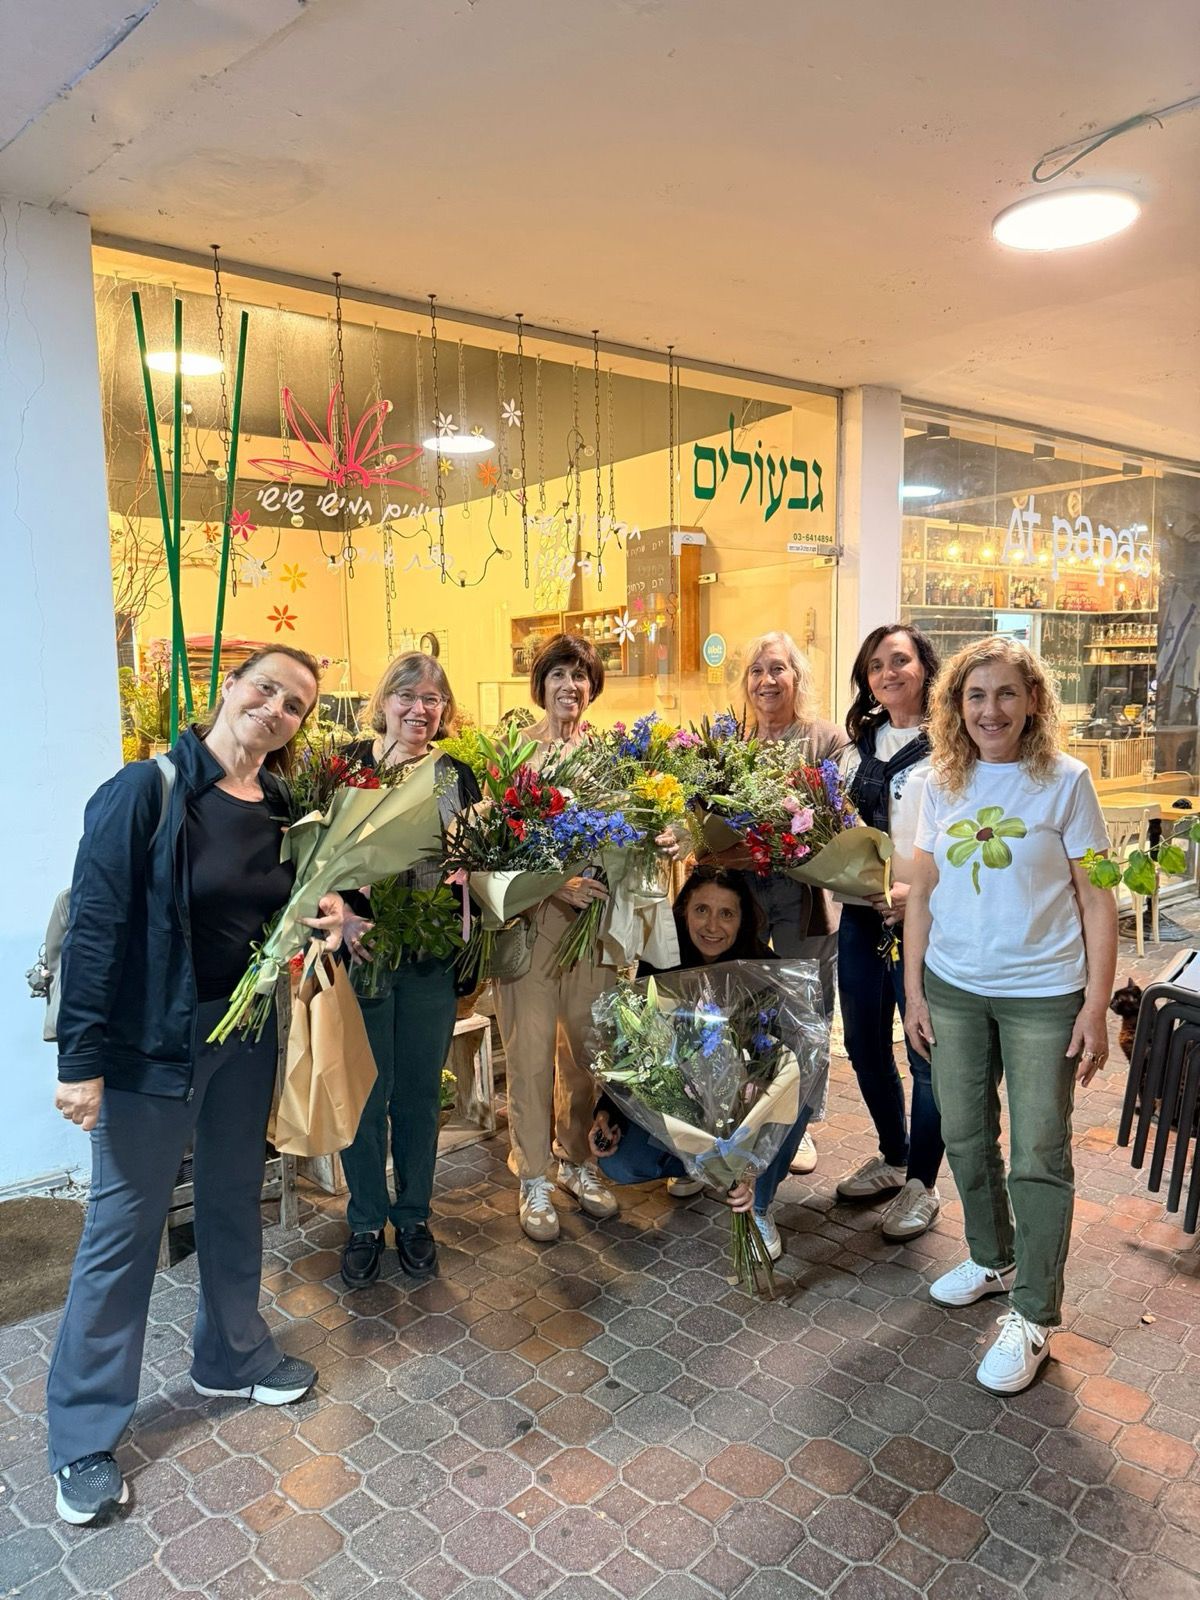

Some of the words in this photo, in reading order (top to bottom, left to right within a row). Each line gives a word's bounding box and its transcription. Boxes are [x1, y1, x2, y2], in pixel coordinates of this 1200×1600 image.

[256, 486, 305, 513] שישי
[316, 492, 373, 517] חמישי
[793, 532, 833, 543] 03-6414894
[1001, 495, 1041, 564] At
